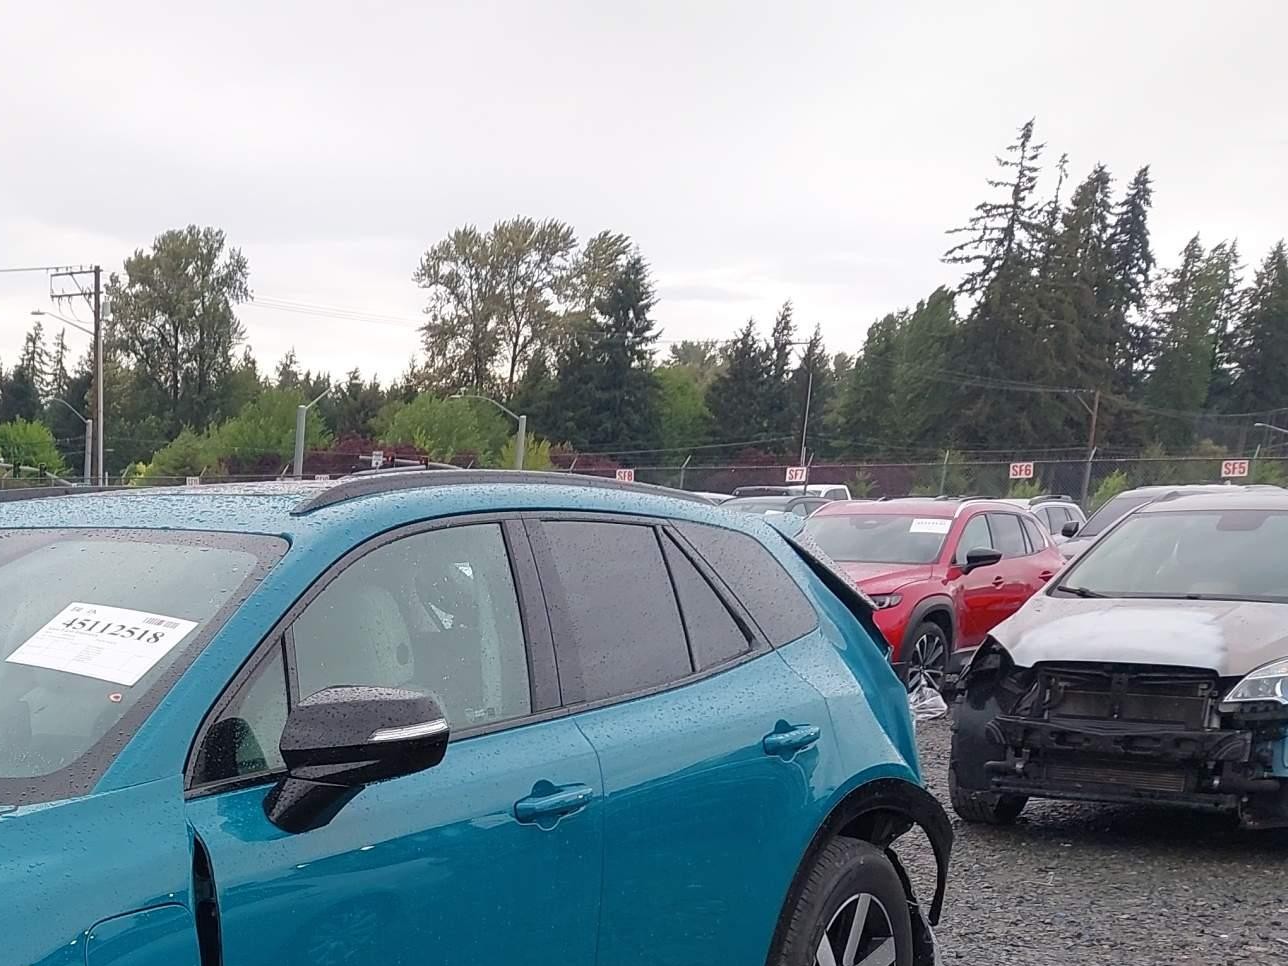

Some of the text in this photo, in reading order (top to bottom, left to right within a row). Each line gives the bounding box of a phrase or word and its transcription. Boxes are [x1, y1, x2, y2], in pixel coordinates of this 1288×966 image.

[788, 469, 804, 480] SF7
[1012, 464, 1032, 477] SF6
[1224, 462, 1246, 475] SF5
[617, 470, 633, 481] SF8
[62, 617, 165, 643] 45112518
